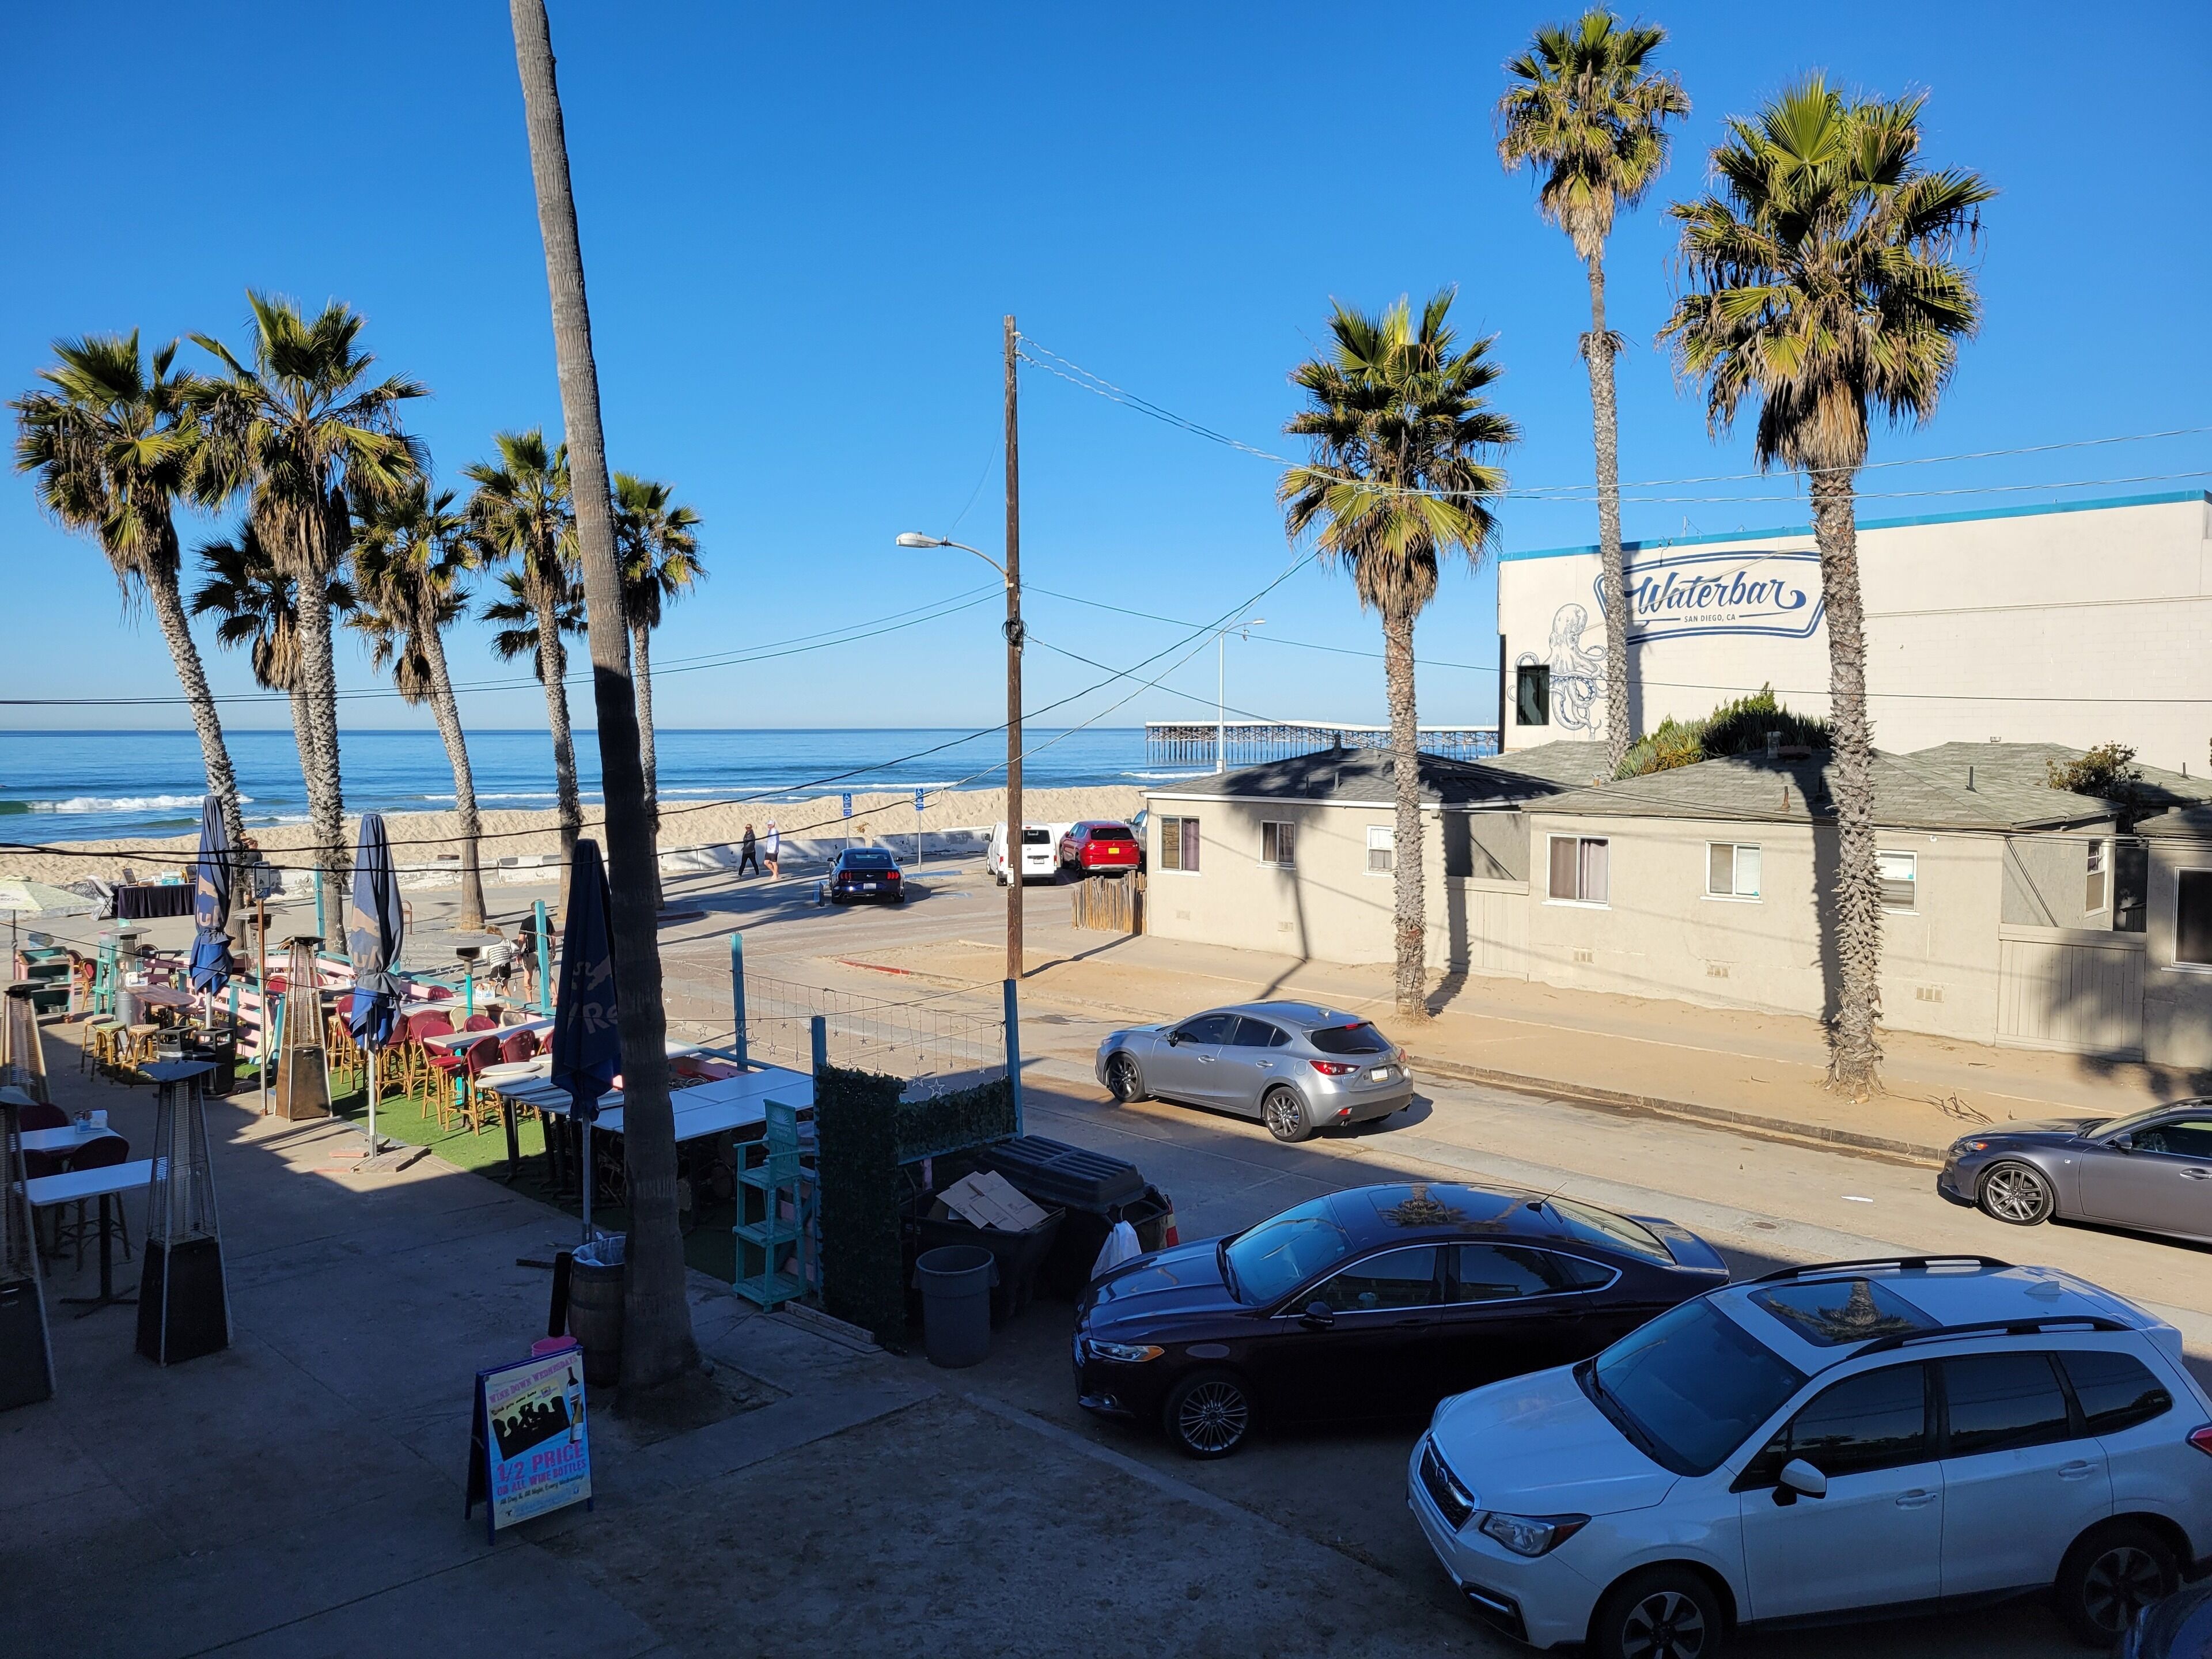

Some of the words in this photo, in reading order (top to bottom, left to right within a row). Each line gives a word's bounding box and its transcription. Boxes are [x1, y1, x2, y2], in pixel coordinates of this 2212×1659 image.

[1624, 571, 1807, 614] Waterbar
[1700, 614, 1724, 622] DIEGO,
[582, 1002, 618, 1035] Re
[488, 1388, 510, 1404] WINE
[510, 1377, 532, 1393] DOWN
[497, 1461, 525, 1482] 1/2
[532, 1440, 583, 1472] PRICE
[498, 1484, 509, 1496] ON
[512, 1479, 526, 1493] ALL
[529, 1470, 551, 1486] WINE
[553, 1459, 586, 1478] BOTTLES
